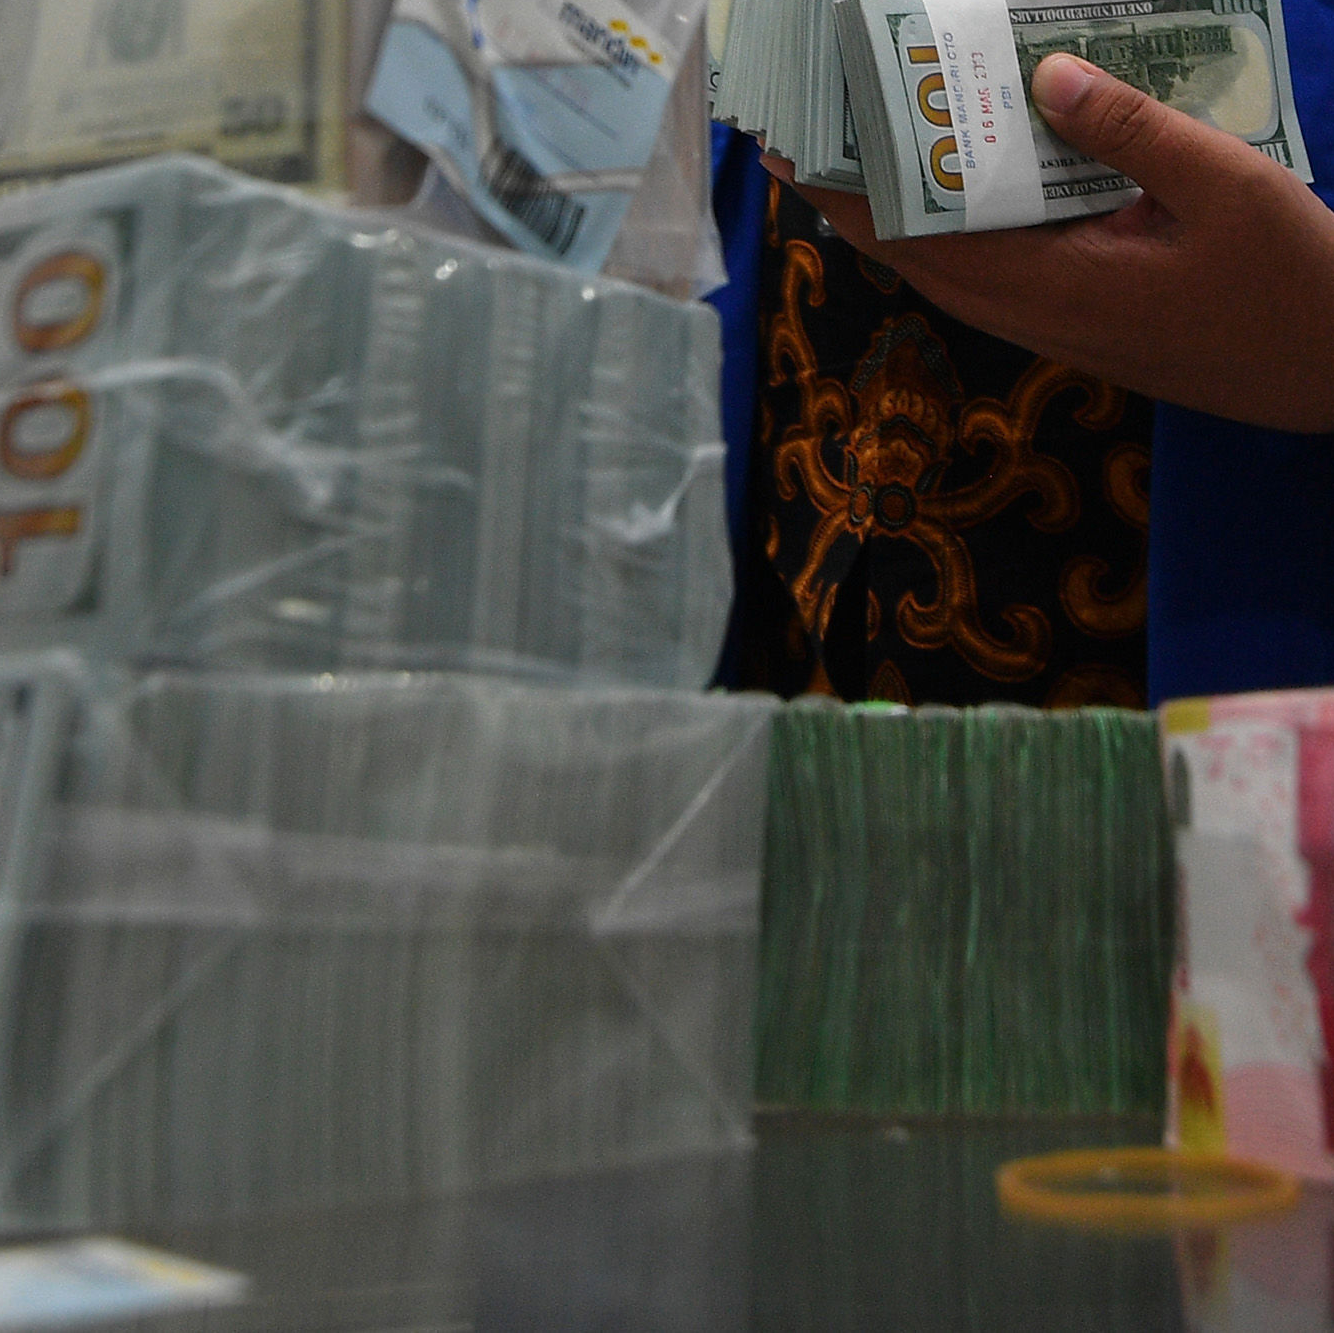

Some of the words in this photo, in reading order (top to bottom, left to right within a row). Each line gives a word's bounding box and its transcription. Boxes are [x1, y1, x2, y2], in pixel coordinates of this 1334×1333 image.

[1010, 7, 1065, 23] DOLLARS
[1065, 3, 1126, 19] HUNDRED
[1127, 1, 1153, 15] ONE
[944, 32, 957, 60] CTO
[951, 61, 966, 124] MANDIRI
[978, 87, 994, 114] MAR
[1000, 85, 1014, 110] PBI
[965, 130, 976, 169] BANK
[1040, 155, 1077, 169] TRUST
